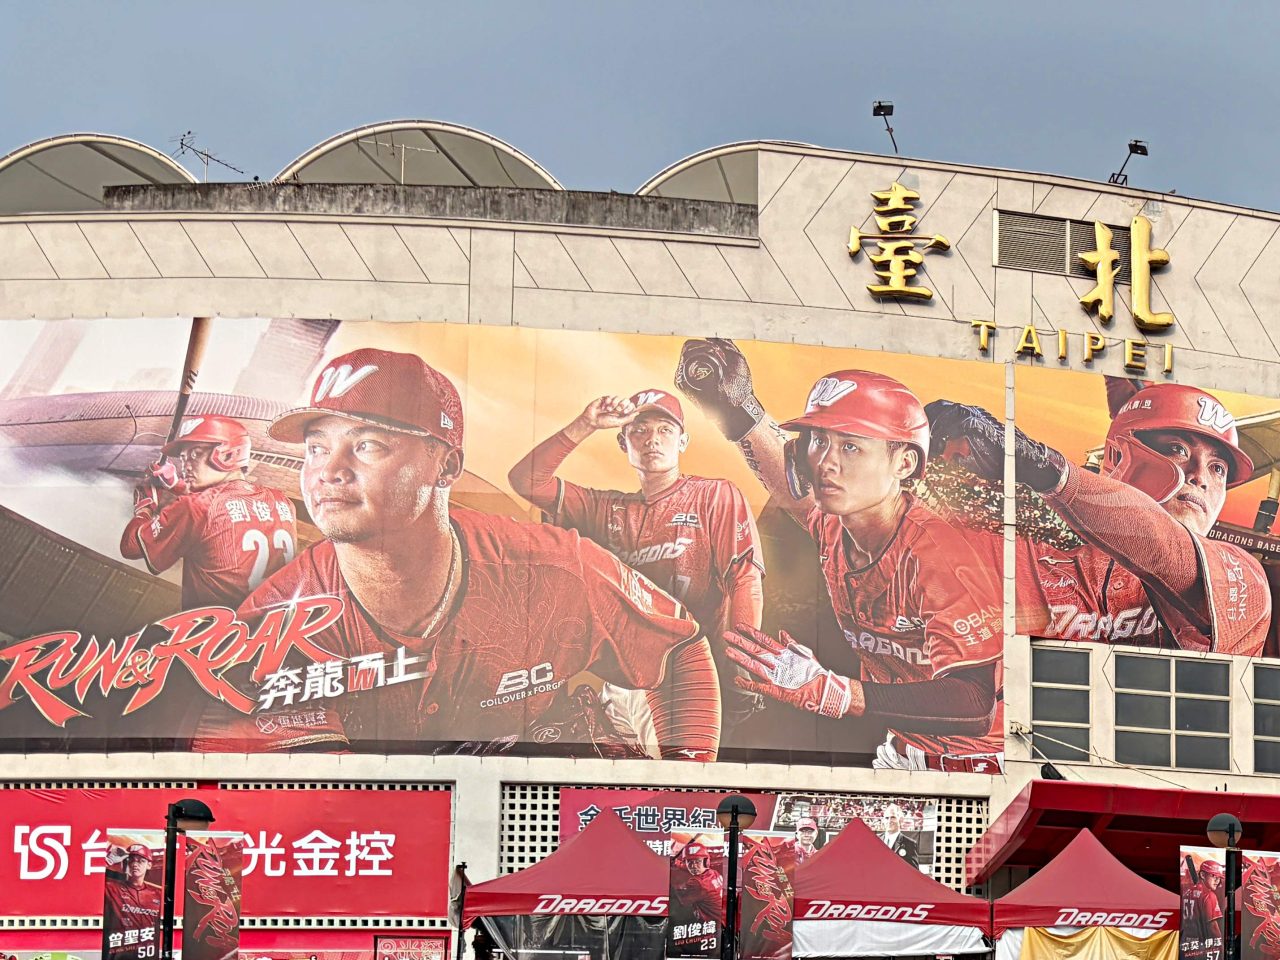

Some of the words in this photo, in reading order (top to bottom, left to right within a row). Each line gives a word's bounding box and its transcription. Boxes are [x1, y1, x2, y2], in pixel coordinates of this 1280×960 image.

[972, 320, 1174, 374] TAIPEI
[1209, 529, 1254, 547] DRAGONS
[496, 662, 554, 696] BC
[480, 690, 526, 708] COILOVER
[533, 894, 669, 914] DRAGONS
[804, 901, 935, 921] DRAGONS
[1054, 908, 1174, 927] DRAGONS
[137, 945, 155, 959] 50
[700, 937, 717, 951] 23
